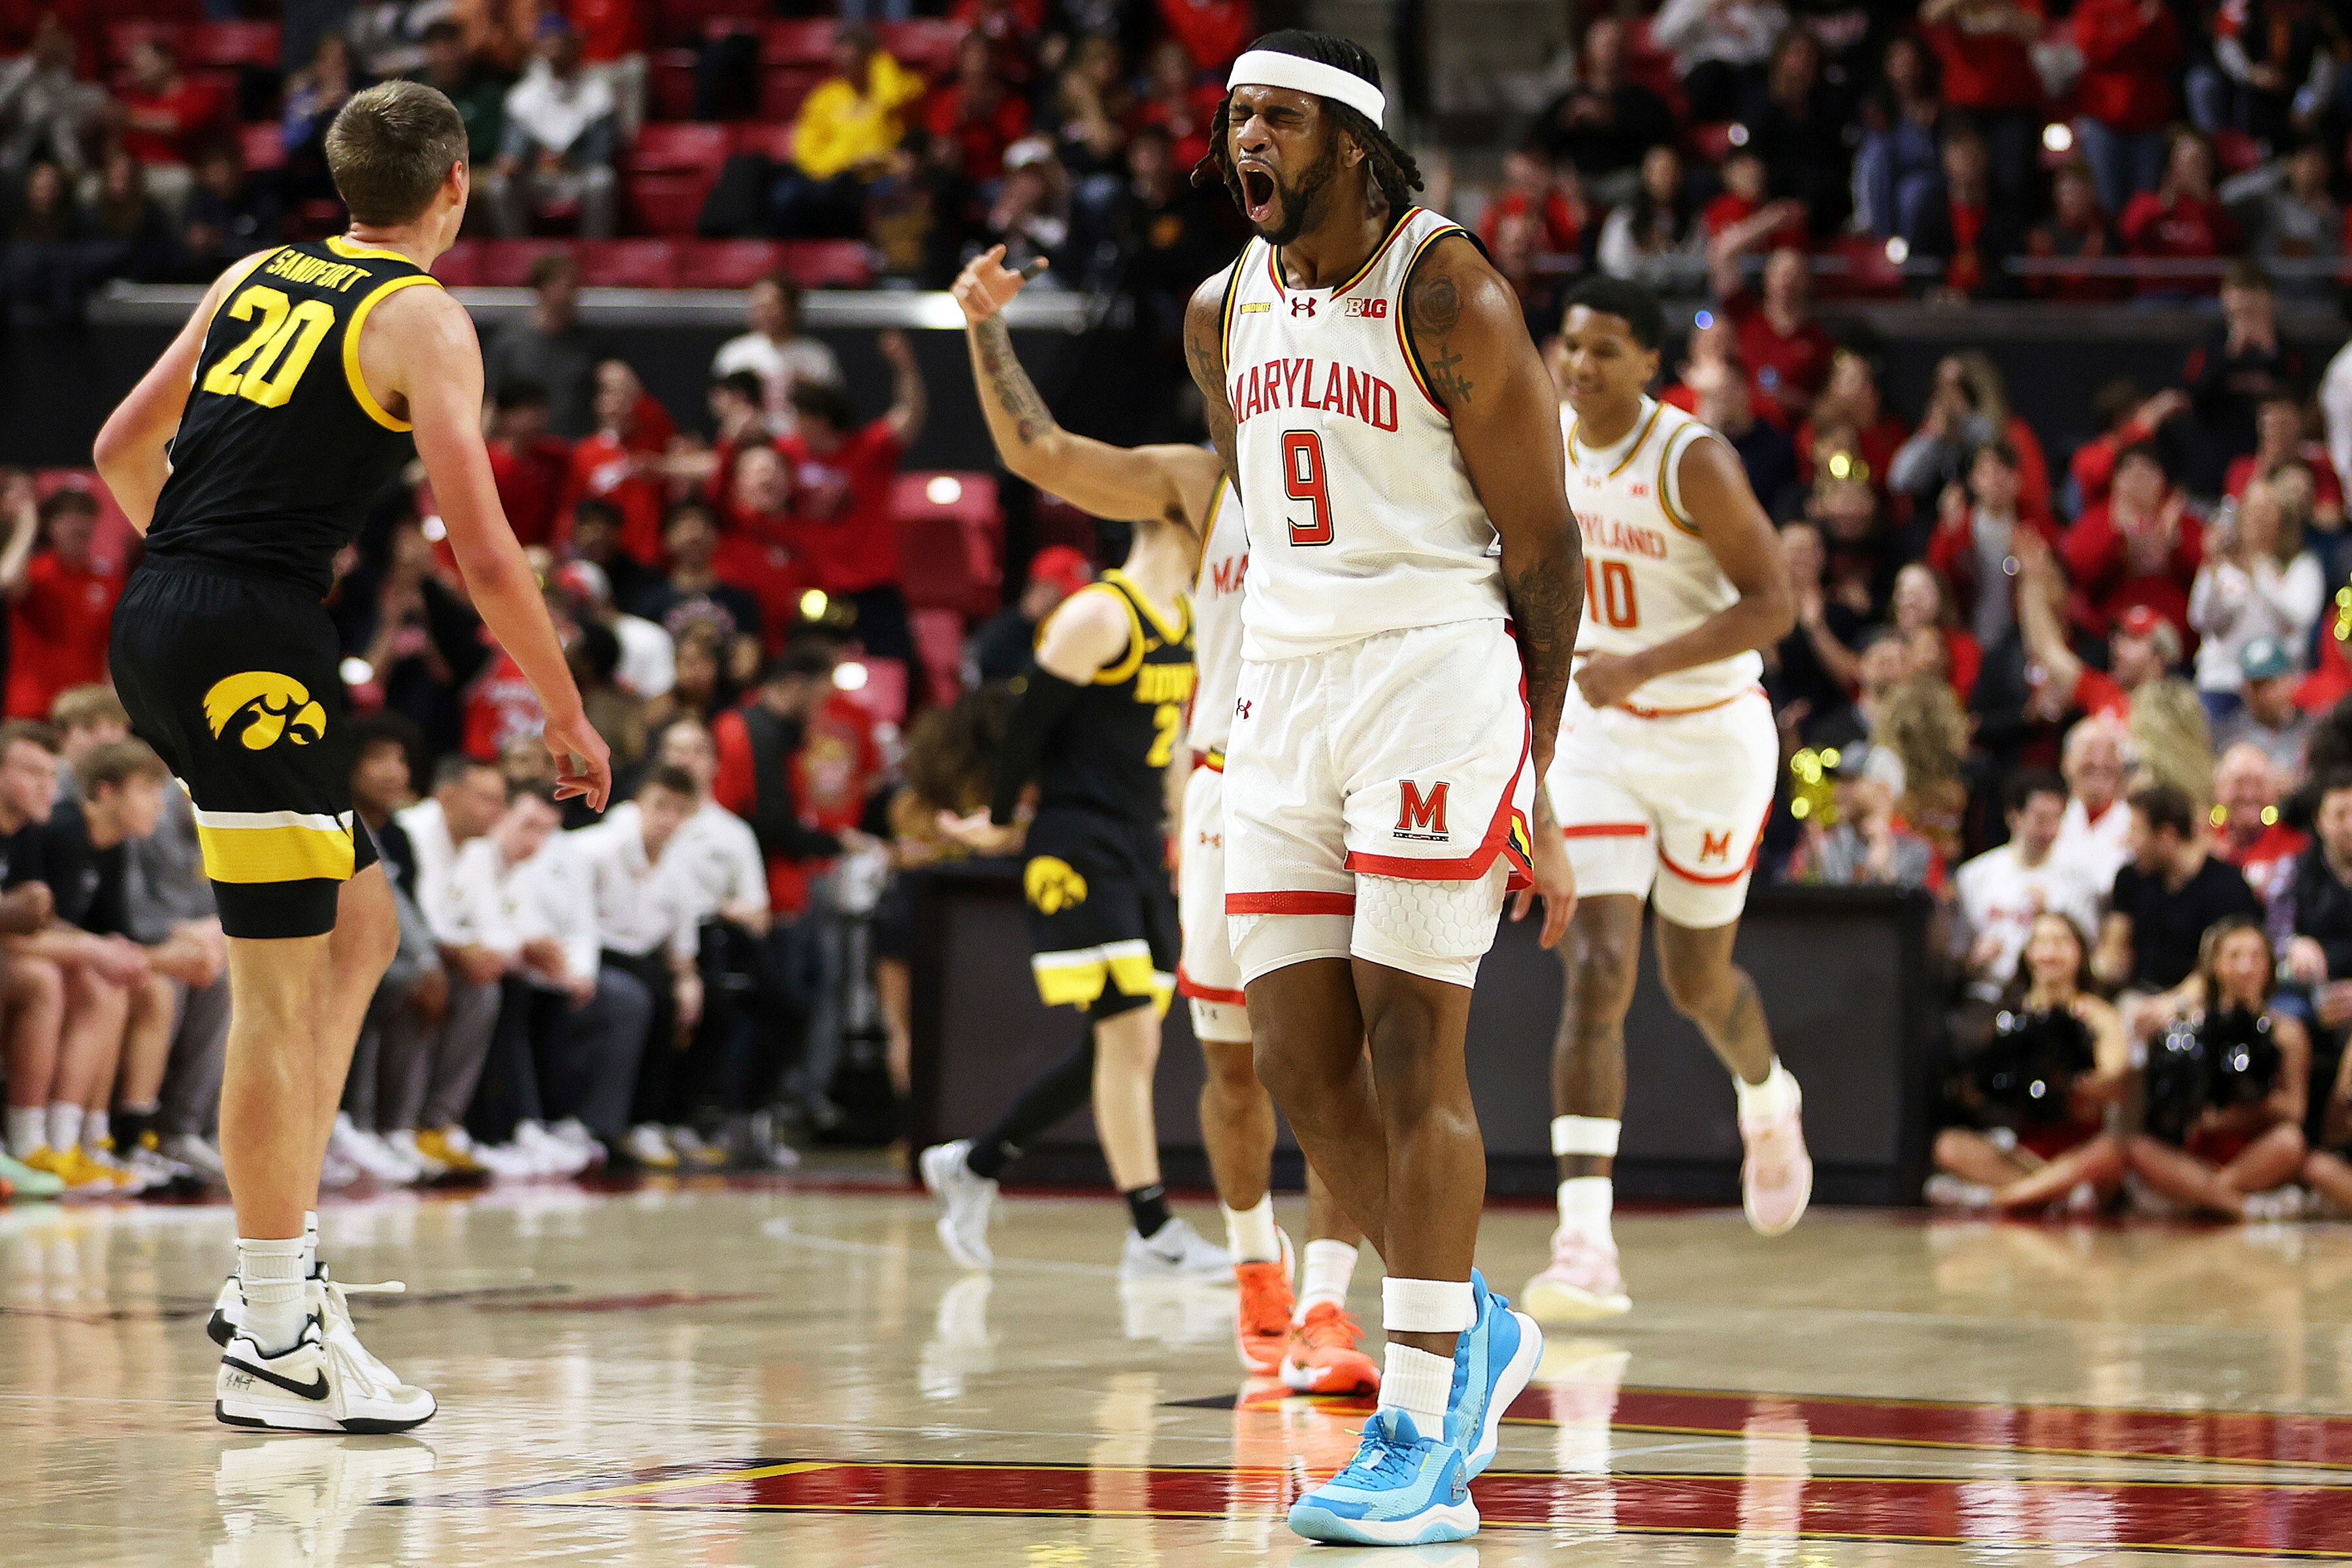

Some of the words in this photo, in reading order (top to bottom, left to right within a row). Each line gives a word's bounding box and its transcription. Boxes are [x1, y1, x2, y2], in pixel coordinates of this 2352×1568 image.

[265, 248, 373, 293] SANDFORT
[203, 284, 335, 408] 20
[1229, 358, 1398, 433] MARYLAND
[1281, 429, 1334, 547] 9
[1584, 557, 1638, 629] 10
[1145, 703, 1180, 768] 2
[1394, 779, 1450, 834] M
[1699, 828, 1732, 864] M
